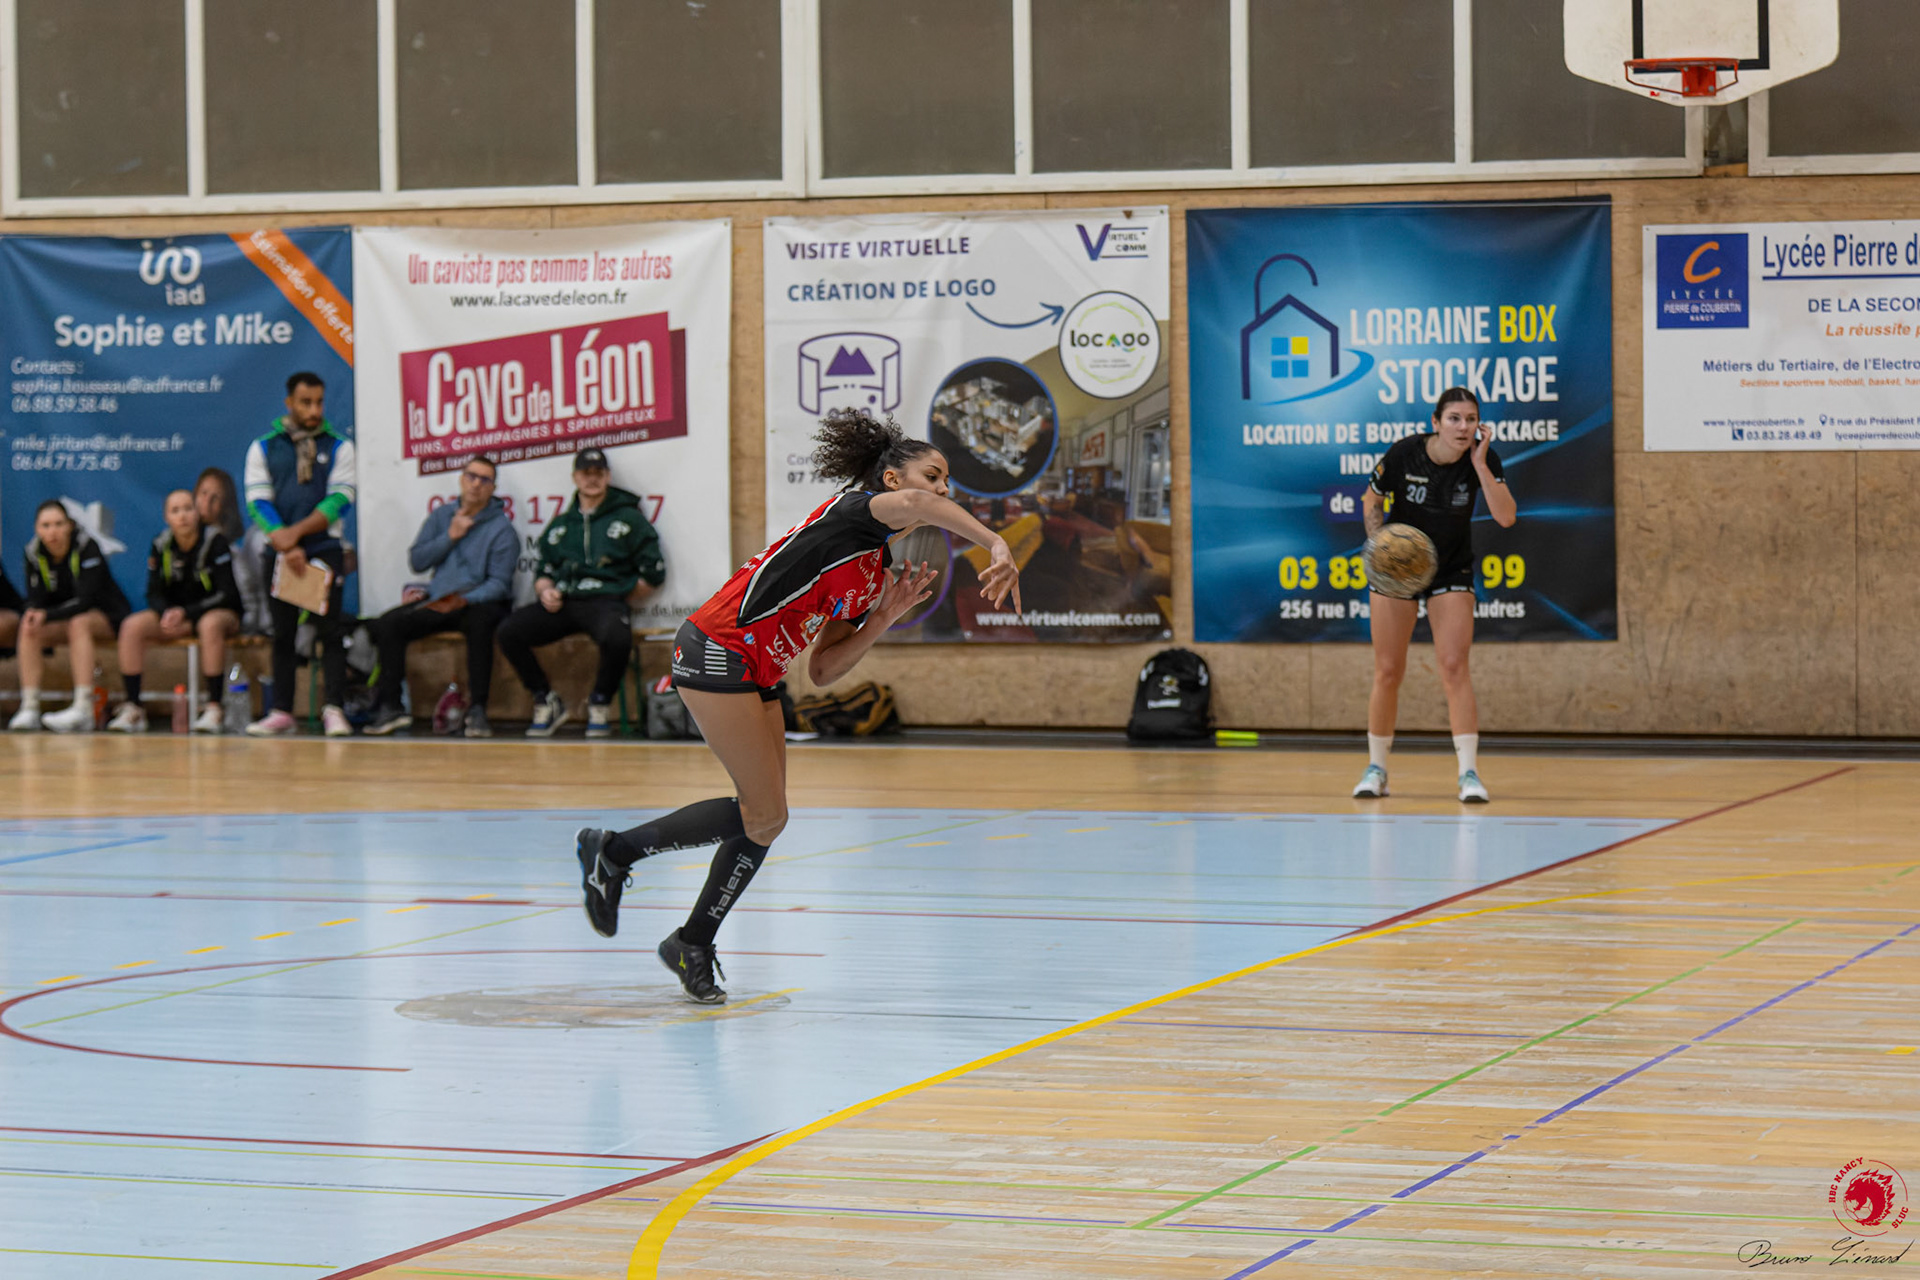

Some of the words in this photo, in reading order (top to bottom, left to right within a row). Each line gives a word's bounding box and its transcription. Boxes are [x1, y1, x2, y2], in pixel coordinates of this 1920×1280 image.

[786, 242, 850, 260] VISITE
[858, 237, 970, 258] VIRTUELLE
[1115, 244, 1147, 252] COMM
[1763, 234, 1826, 276] Lycée
[1834, 233, 1898, 267] Pierre
[1906, 232, 1920, 267] d
[250, 230, 315, 298] Estimation
[408, 254, 429, 284] Un
[433, 254, 491, 284] caviste
[497, 261, 526, 288] pas
[530, 258, 589, 282] comme
[593, 251, 616, 281] les
[620, 250, 672, 280] autres
[165, 284, 206, 306] iad
[450, 290, 628, 307] www.lacavedeleon.fr
[787, 279, 895, 301] CRÉATION
[903, 281, 928, 298] DE
[935, 279, 996, 298] LOGO
[1671, 288, 1733, 300] LYCÉE
[1663, 303, 1690, 314] PIERRE
[1700, 302, 1742, 314] COUBERTIN
[1808, 298, 1832, 312] DE
[1838, 298, 1861, 312] LA
[1350, 306, 1491, 346] LORRAINE
[1499, 304, 1557, 343] BOX
[1689, 314, 1715, 322] NANCY
[1825, 324, 1844, 336] La
[1849, 322, 1911, 336] réussite
[54, 315, 164, 355] Sophie
[172, 319, 207, 346] et
[215, 313, 293, 345] Mike
[1703, 360, 1752, 373] Métiers
[1757, 360, 1774, 372] du
[1779, 359, 1839, 372] Tertiaire,
[1843, 358, 1860, 371] de
[408, 400, 426, 440] la
[427, 351, 525, 438] Cave
[527, 381, 552, 423] de
[550, 326, 656, 421] Léon
[1378, 356, 1558, 405] STOCKAGE
[1739, 379, 1780, 387] Sections
[1783, 378, 1825, 388] sportives
[451, 424, 550, 450] CHAMPAGNES
[553, 422, 564, 435] &
[567, 409, 656, 433] SPIRITUEUX
[1837, 418, 1852, 426] rue
[1854, 417, 1867, 426] du
[1870, 416, 1914, 426] Président
[1243, 424, 1328, 446] LOCATION
[1335, 423, 1358, 444] DE
[1746, 431, 1822, 441] 03.83.28.49.49
[422, 460, 444, 472] des
[500, 448, 524, 462] pro
[525, 443, 555, 459] pour
[555, 440, 575, 453] les
[577, 428, 649, 450] particuliers
[787, 471, 805, 484] 07
[1330, 492, 1355, 514] de
[1405, 483, 1427, 504] 20
[527, 496, 566, 524] 17
[1278, 555, 1319, 590] 03
[1328, 555, 1368, 590] 83
[1481, 554, 1526, 589] 99
[976, 610, 1160, 627] www.virtuelcomm.com
[1280, 601, 1312, 619] 256
[1317, 603, 1345, 619] rue
